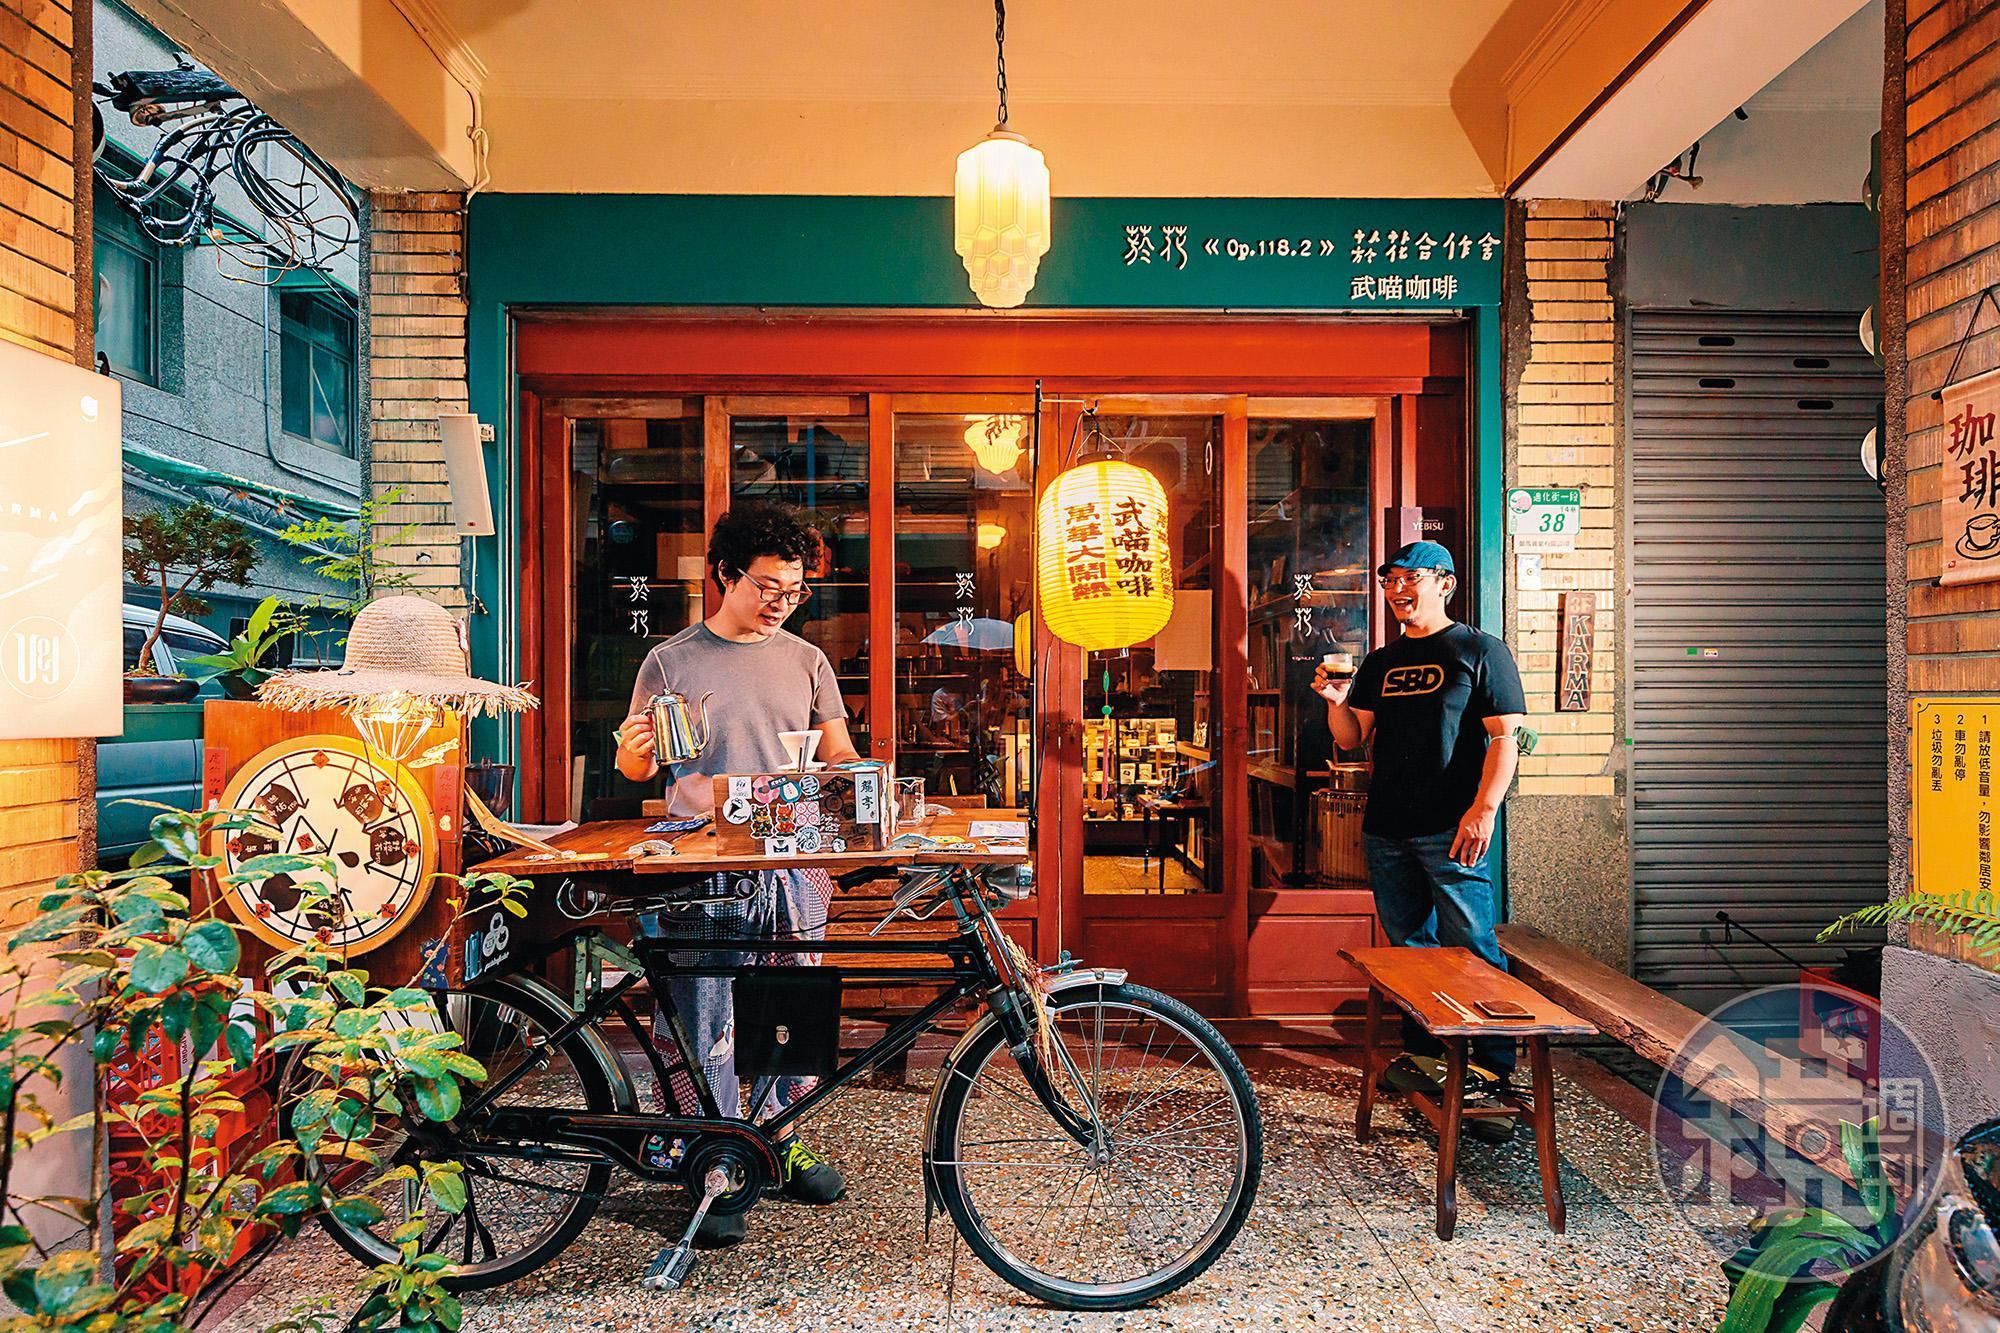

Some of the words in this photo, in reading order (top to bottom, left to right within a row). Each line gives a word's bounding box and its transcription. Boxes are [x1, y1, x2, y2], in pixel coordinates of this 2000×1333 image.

[1351, 274, 1458, 300] 武喵咖啡
[1947, 404, 2000, 510] 珈琲
[1539, 513, 1565, 532] 38
[1110, 496, 1154, 598] 武喵咖啡
[1564, 614, 1592, 710] KARMA
[1381, 664, 1444, 697] SBD
[1933, 714, 1941, 725] 3
[1957, 714, 1964, 725] 2
[1982, 714, 1988, 725] 1
[1931, 729, 1943, 792] 垃圾勿亂丟
[1954, 729, 1967, 781] 車勿亂停
